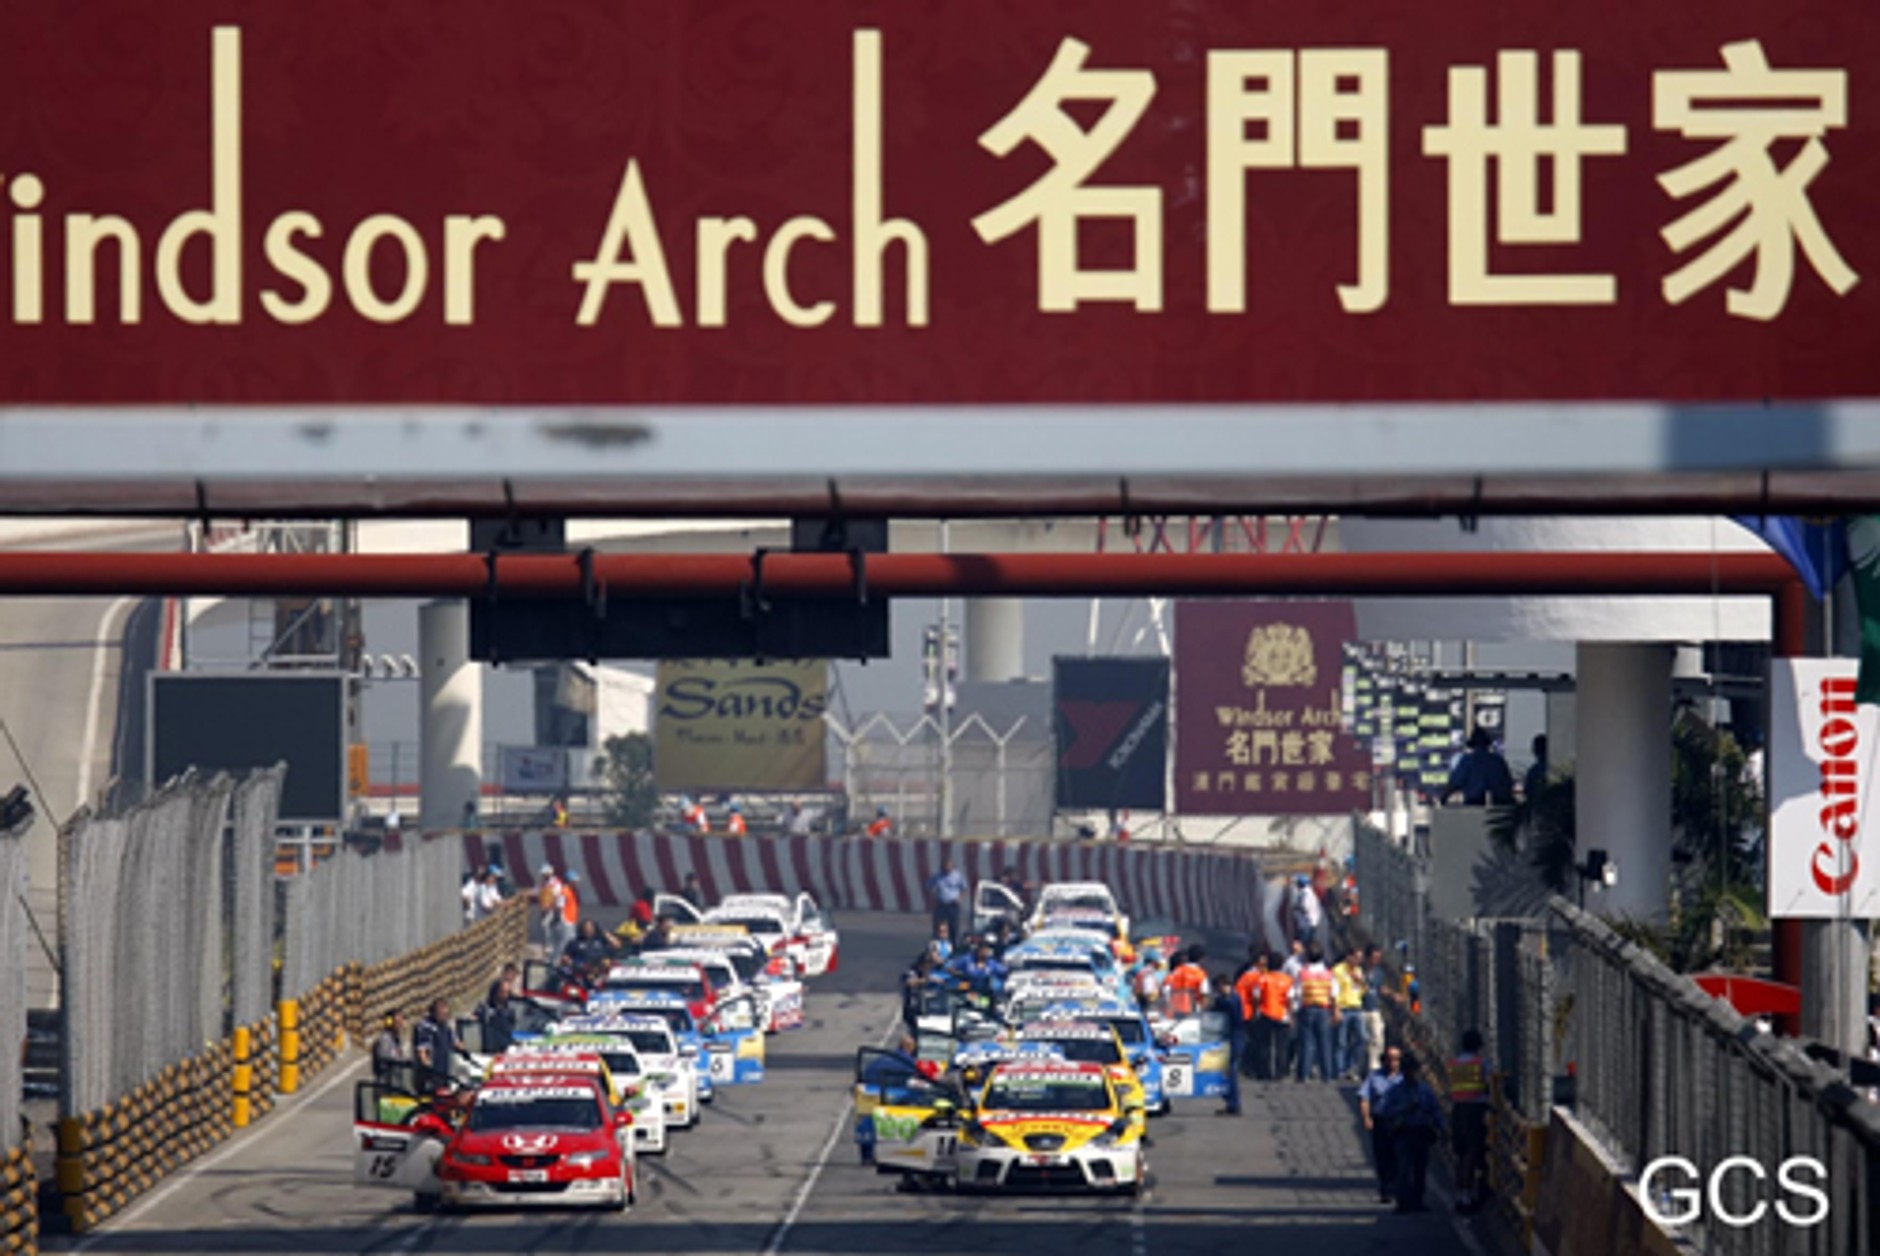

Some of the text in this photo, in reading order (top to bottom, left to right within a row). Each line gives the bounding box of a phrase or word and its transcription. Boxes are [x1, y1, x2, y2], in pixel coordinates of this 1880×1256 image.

[0, 26, 930, 327] indsor Arch
[970, 36, 1861, 321] 名門世家
[662, 676, 826, 720] Sands
[1216, 688, 1295, 726] Windsor
[1226, 730, 1334, 766] 名門世家
[1810, 677, 1859, 896] Canon
